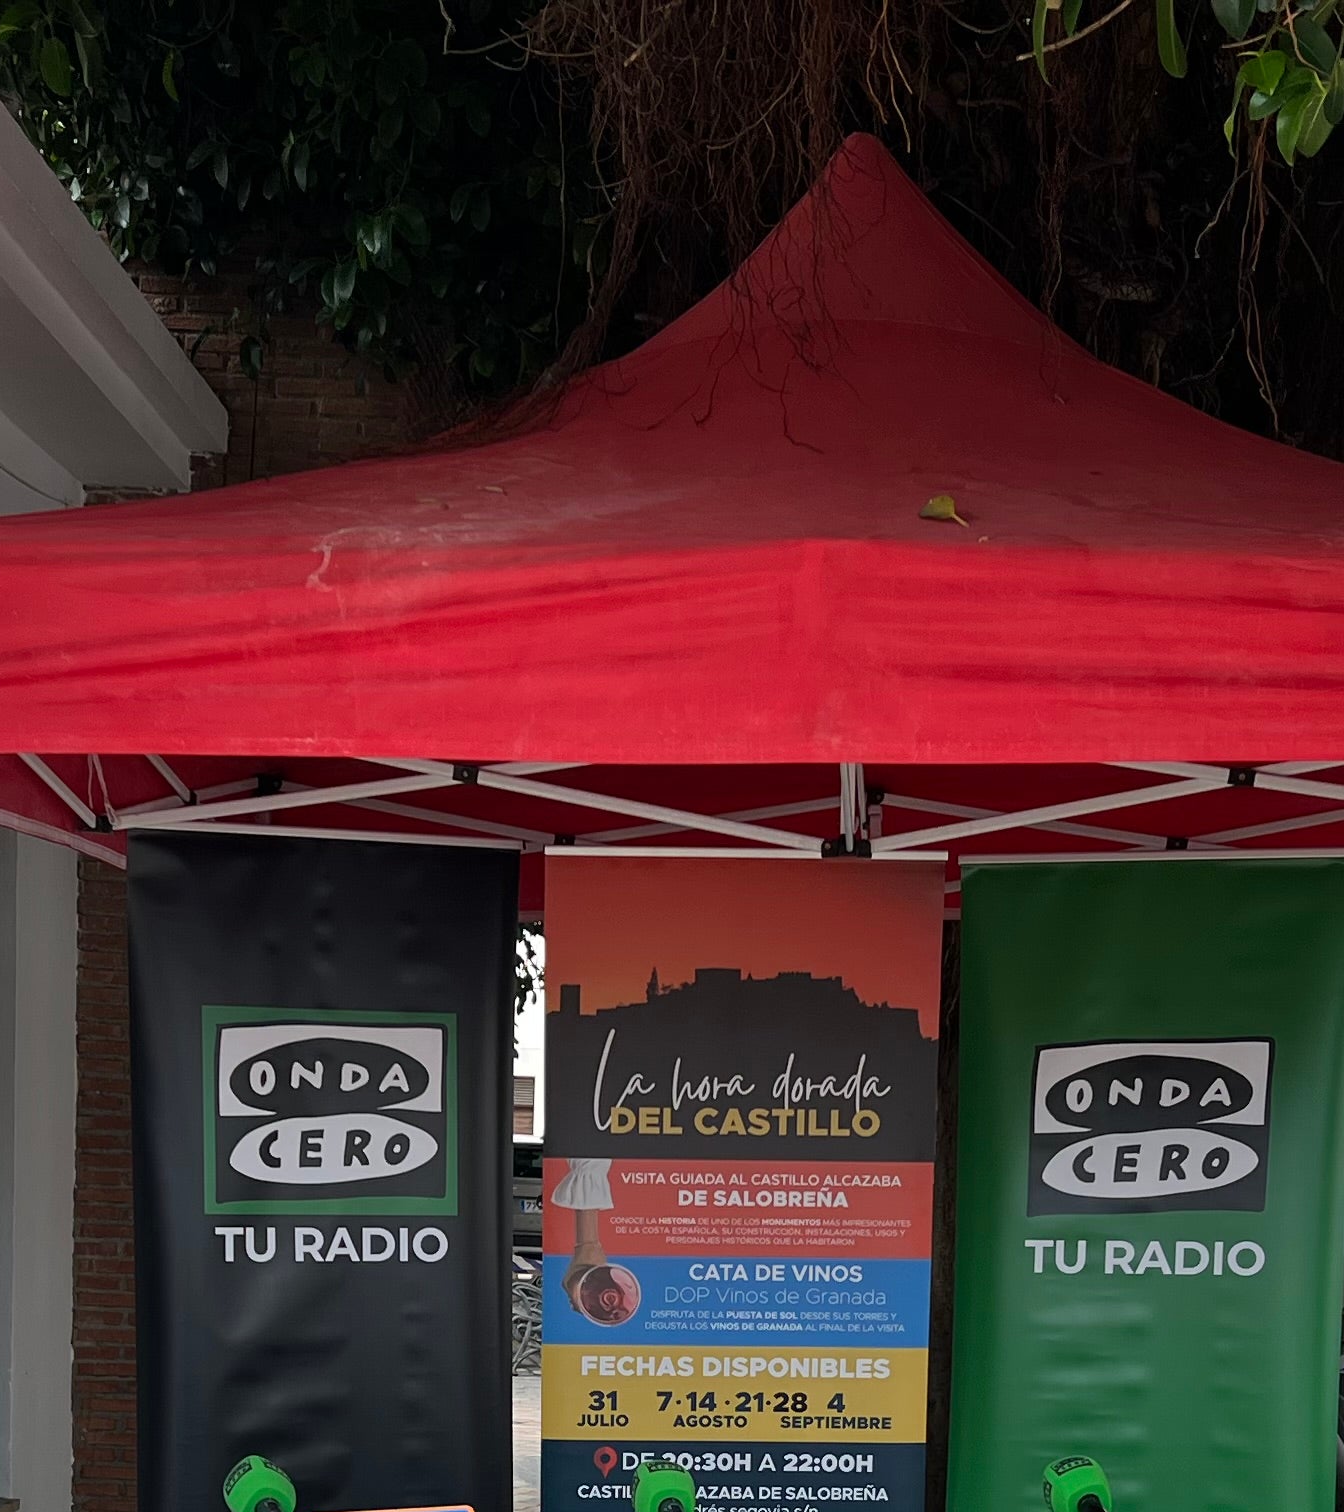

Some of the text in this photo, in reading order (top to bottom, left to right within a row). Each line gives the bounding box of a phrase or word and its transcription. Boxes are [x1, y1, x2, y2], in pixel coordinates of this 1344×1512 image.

[249, 1060, 410, 1096] ONDA
[593, 1028, 891, 1131] La hora dorada
[1066, 1078, 1232, 1113] ONDA
[610, 1106, 881, 1137] DEL CASTILLO
[259, 1129, 410, 1168] CERO
[1072, 1143, 1230, 1183] CERO
[621, 1173, 901, 1187] VISITA GUIADA AL CASTILLO ALCAZABA
[678, 1187, 848, 1208] DE SALOBREÑA
[762, 1218, 821, 1226] MONUMENTOS
[215, 1227, 449, 1262] TU RADIO
[1025, 1240, 1265, 1276] TU RADIO
[689, 1264, 863, 1282] CATA DE VINOS
[665, 1287, 886, 1305] DOP Vinos de Granada
[756, 1323, 803, 1331] GRANADA
[581, 1355, 891, 1378] FECHAS DISPONIBLES
[588, 1391, 845, 1412] 31 4
[577, 1414, 892, 1430] JULIO AGOSTO SEPTIEMBRE
[759, 1454, 776, 1472] A
[783, 1454, 873, 1472] 22:00H
[759, 1487, 782, 1500] DE
[785, 1484, 888, 1501] SALOBREÑA
